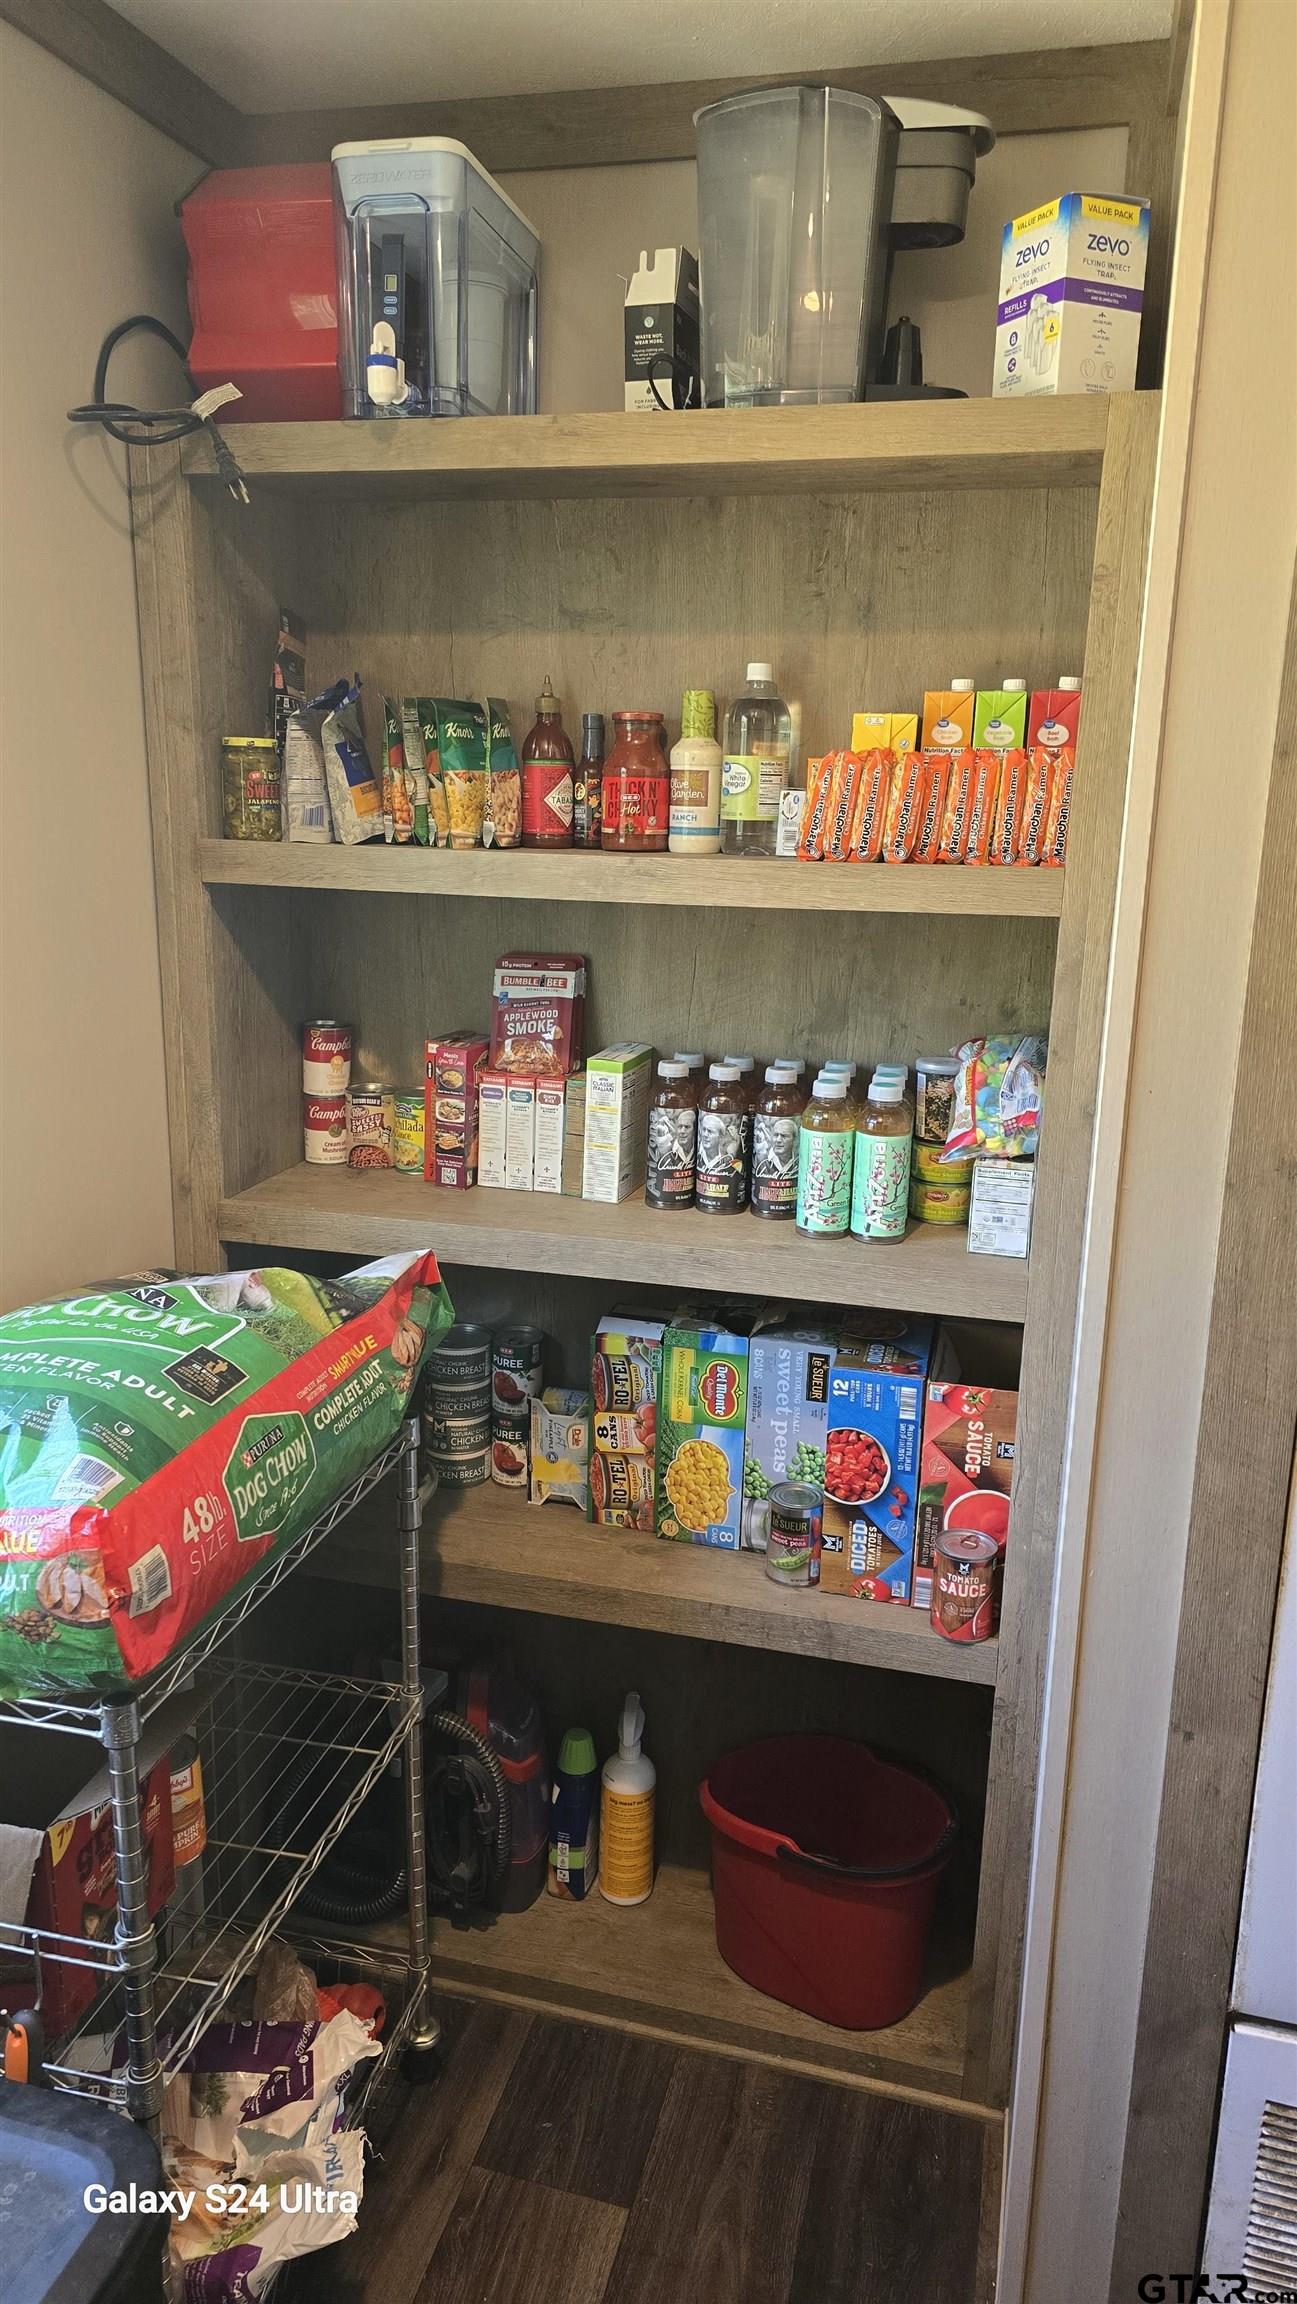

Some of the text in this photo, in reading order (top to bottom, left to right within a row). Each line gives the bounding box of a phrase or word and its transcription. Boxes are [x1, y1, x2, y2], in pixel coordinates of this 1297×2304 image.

[1017, 208, 1054, 231] VALUE PACK
[1088, 204, 1134, 221] VALUE PACK
[1015, 239, 1050, 268] zevo
[1087, 233, 1130, 257] zevo
[1012, 262, 1051, 285] FLYING INSECT
[1082, 257, 1131, 273] FLYING INSECT
[1004, 299, 1028, 316] REFILLS
[1049, 323, 1055, 333] 6
[445, 721, 475, 740] Knorr
[671, 777, 689, 789] Olive
[622, 801, 641, 816] Hot
[672, 814, 698, 822] RANCH
[894, 764, 919, 852] Maruchan Ramen
[919, 772, 940, 856] Maruchan Ramen
[949, 768, 971, 854] Maruchan Ramen
[968, 768, 987, 856] Maruchan Ramen
[1002, 767, 1018, 854] Maruchan Ramen
[1054, 768, 1074, 857] Maruchan Ramen
[806, 800, 824, 848] Maruchan
[832, 802, 848, 852] Maruchan
[859, 804, 875, 854] Maruchan
[979, 816, 987, 839] Chicken
[1026, 802, 1043, 852] Maruchan
[501, 960, 512, 968] 15g
[503, 976, 565, 987] BUMBLE BEE
[504, 1009, 559, 1022] APPLEWOOD
[507, 1019, 555, 1036] SMOKE
[352, 1115, 376, 1125] SWEET
[352, 1119, 382, 1133] SASSY
[977, 1168, 1012, 1177] Supplement
[827, 1200, 847, 1208] Green
[61, 1296, 214, 1337] CHOW
[493, 1354, 524, 1369] PUREE
[867, 1343, 886, 1364] DICED
[38, 1366, 116, 1391] FLAVOR
[460, 1363, 486, 1375] BREAST
[0, 1352, 101, 1373] MPLETE
[101, 1367, 196, 1420] ADULT
[632, 1366, 640, 1401] Original
[677, 1375, 685, 1399] KERNEL
[714, 1365, 729, 1417] Del Monte
[811, 1368, 824, 1400] SUEUR
[833, 1380, 849, 1397] 12
[314, 1379, 364, 1431] COMPLETE
[333, 1382, 388, 1436] CHICKEN FLAVOR
[435, 1402, 471, 1412] CHICKEN
[676, 1400, 685, 1420] CORN
[770, 1348, 792, 1473] sweet peas
[450, 1433, 484, 1447] CHICKEN
[493, 1426, 522, 1441] PUREE
[572, 1428, 583, 1447] Dole
[597, 1426, 610, 1439] 8
[609, 1415, 618, 1450] CANS
[250, 1428, 283, 1461] PURINA
[964, 1420, 985, 1474] SAUCE
[982, 1432, 993, 1467] TOMATO
[233, 1433, 308, 1520] DOG CHOW
[460, 1465, 486, 1479] BREAST
[631, 1466, 639, 1501] Original
[719, 1530, 734, 1542] 8
[779, 1520, 808, 1532] SUEUR
[189, 1523, 229, 1575] SIZE
[850, 1522, 868, 1571] DICED
[866, 1526, 878, 1571] TOMATOES
[939, 1578, 987, 1598] SAUCE
[947, 1572, 980, 1584] TOMATO
[177, 1823, 200, 1840] PURE
[295, 2033, 309, 2059] PADS
[335, 2070, 352, 2091] XXL
